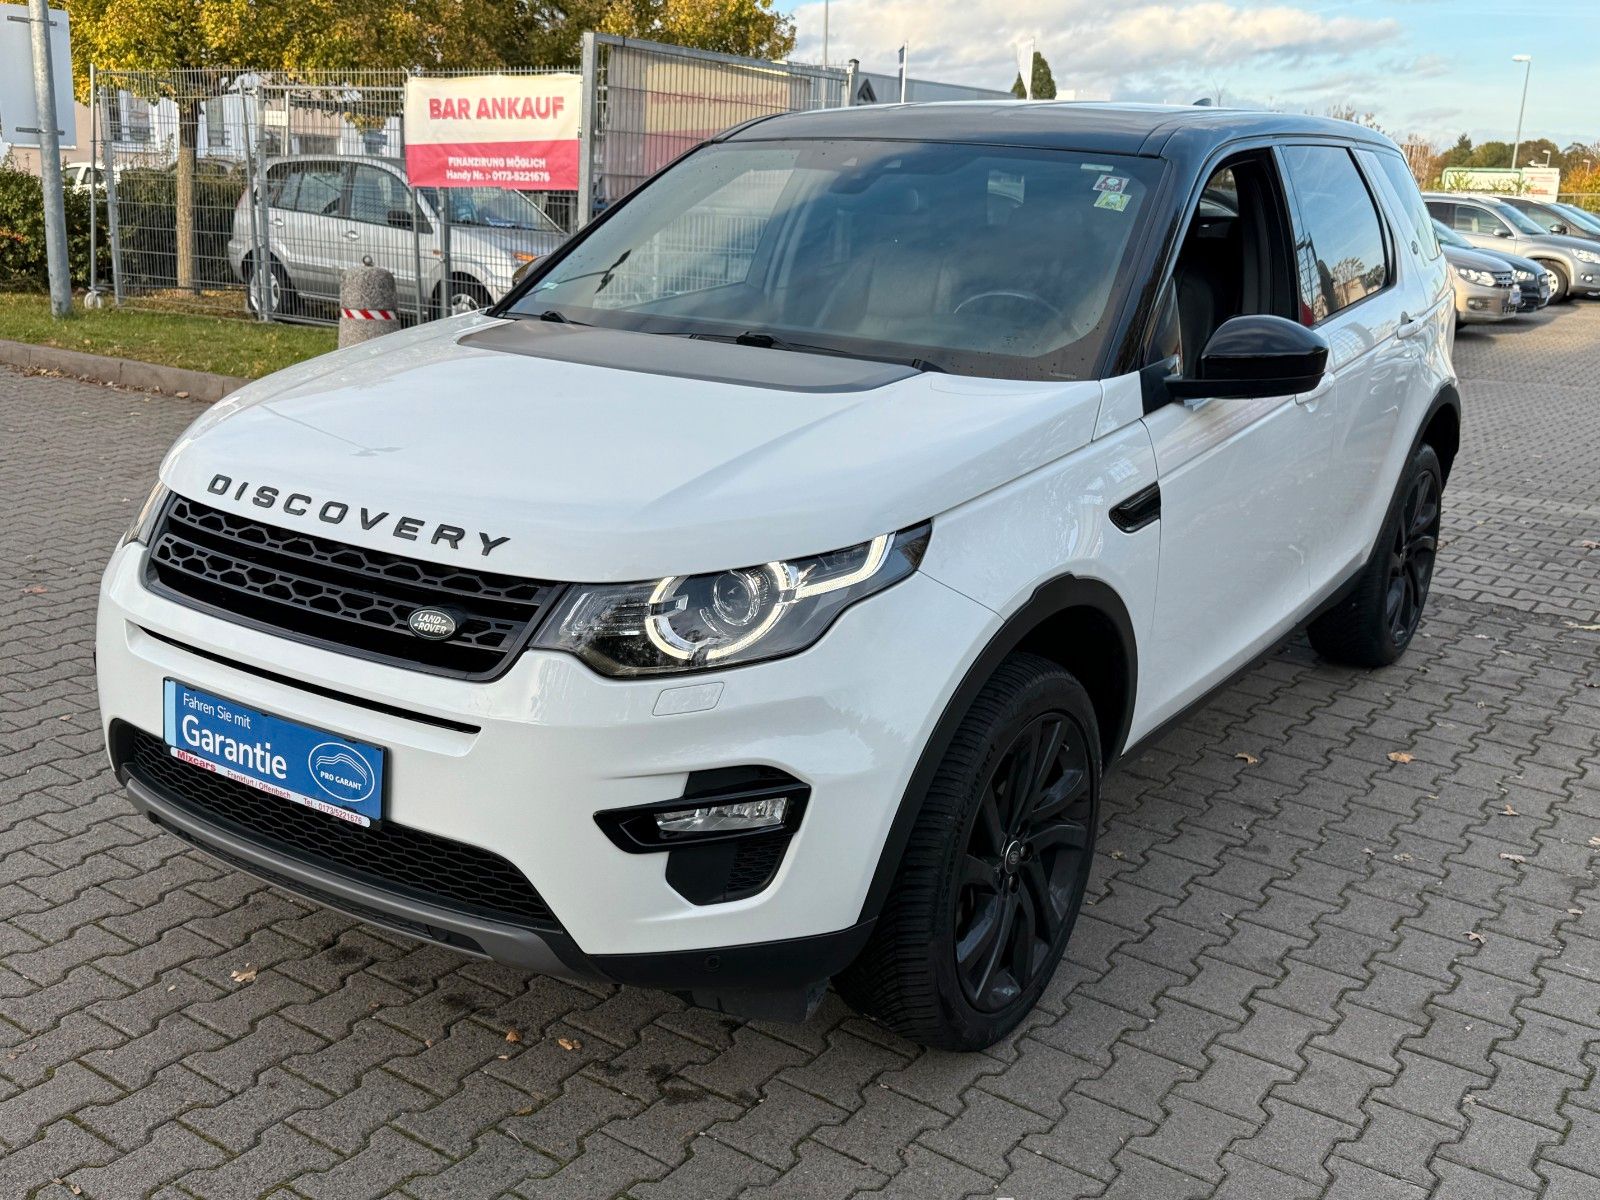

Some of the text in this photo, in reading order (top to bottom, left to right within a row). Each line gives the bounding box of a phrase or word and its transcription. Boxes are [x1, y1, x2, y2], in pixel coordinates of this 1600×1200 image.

[429, 96, 565, 120] BAR ANKAUF
[506, 155, 546, 169] MÖGLICH
[446, 169, 472, 182] Handy
[491, 170, 551, 183] 0173-5221676
[207, 473, 511, 557] DISCOVERY
[417, 613, 442, 624] LAND
[418, 622, 448, 634] ROVER
[183, 692, 251, 730] Fahren Sie mit
[181, 714, 287, 779] Garantie
[177, 749, 217, 773] Mixcars
[227, 770, 255, 786] Frankfurt
[258, 782, 291, 799] Offenbach
[318, 803, 363, 825] 0173/5221676
[320, 770, 362, 791] PRO GARANT
